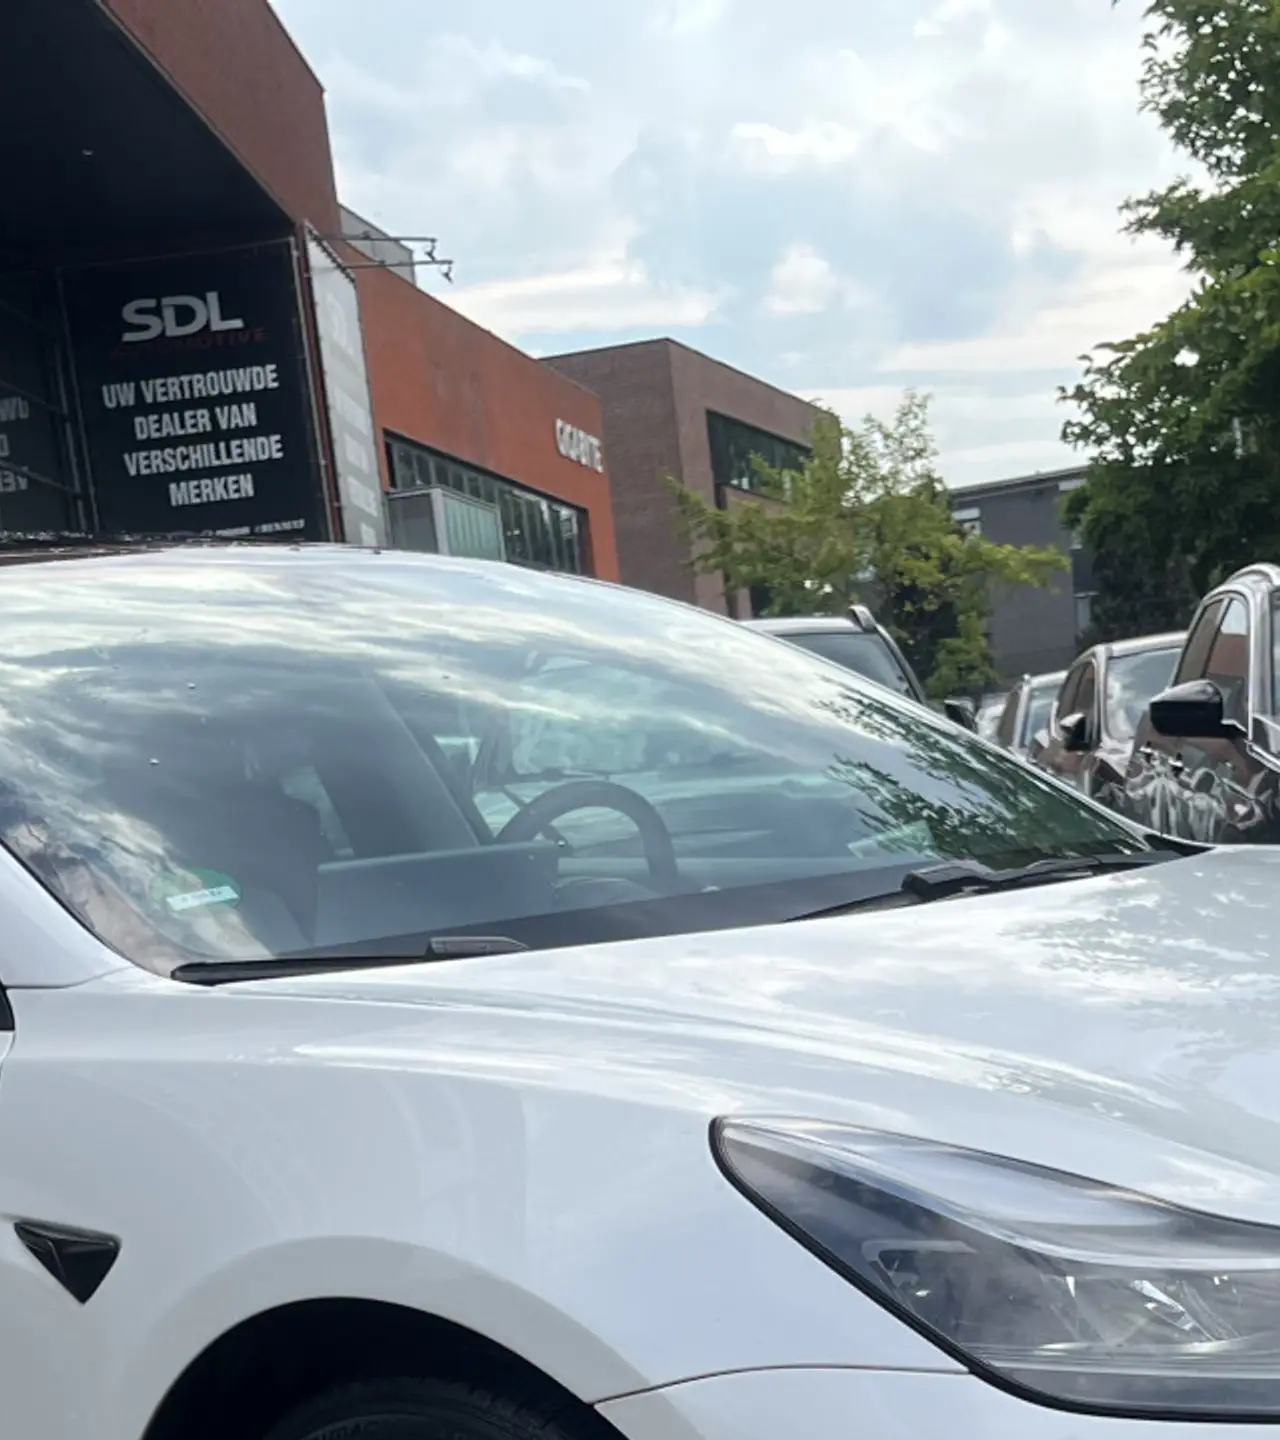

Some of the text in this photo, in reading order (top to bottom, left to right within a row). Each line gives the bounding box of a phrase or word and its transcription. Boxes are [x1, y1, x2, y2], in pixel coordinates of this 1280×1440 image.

[122, 291, 245, 342] SDL
[102, 363, 279, 409] UW VERTROUWDE
[134, 402, 258, 441] DEALER VAN
[123, 434, 284, 477] VERSCHILLENDE
[169, 473, 255, 507] MERKEN
